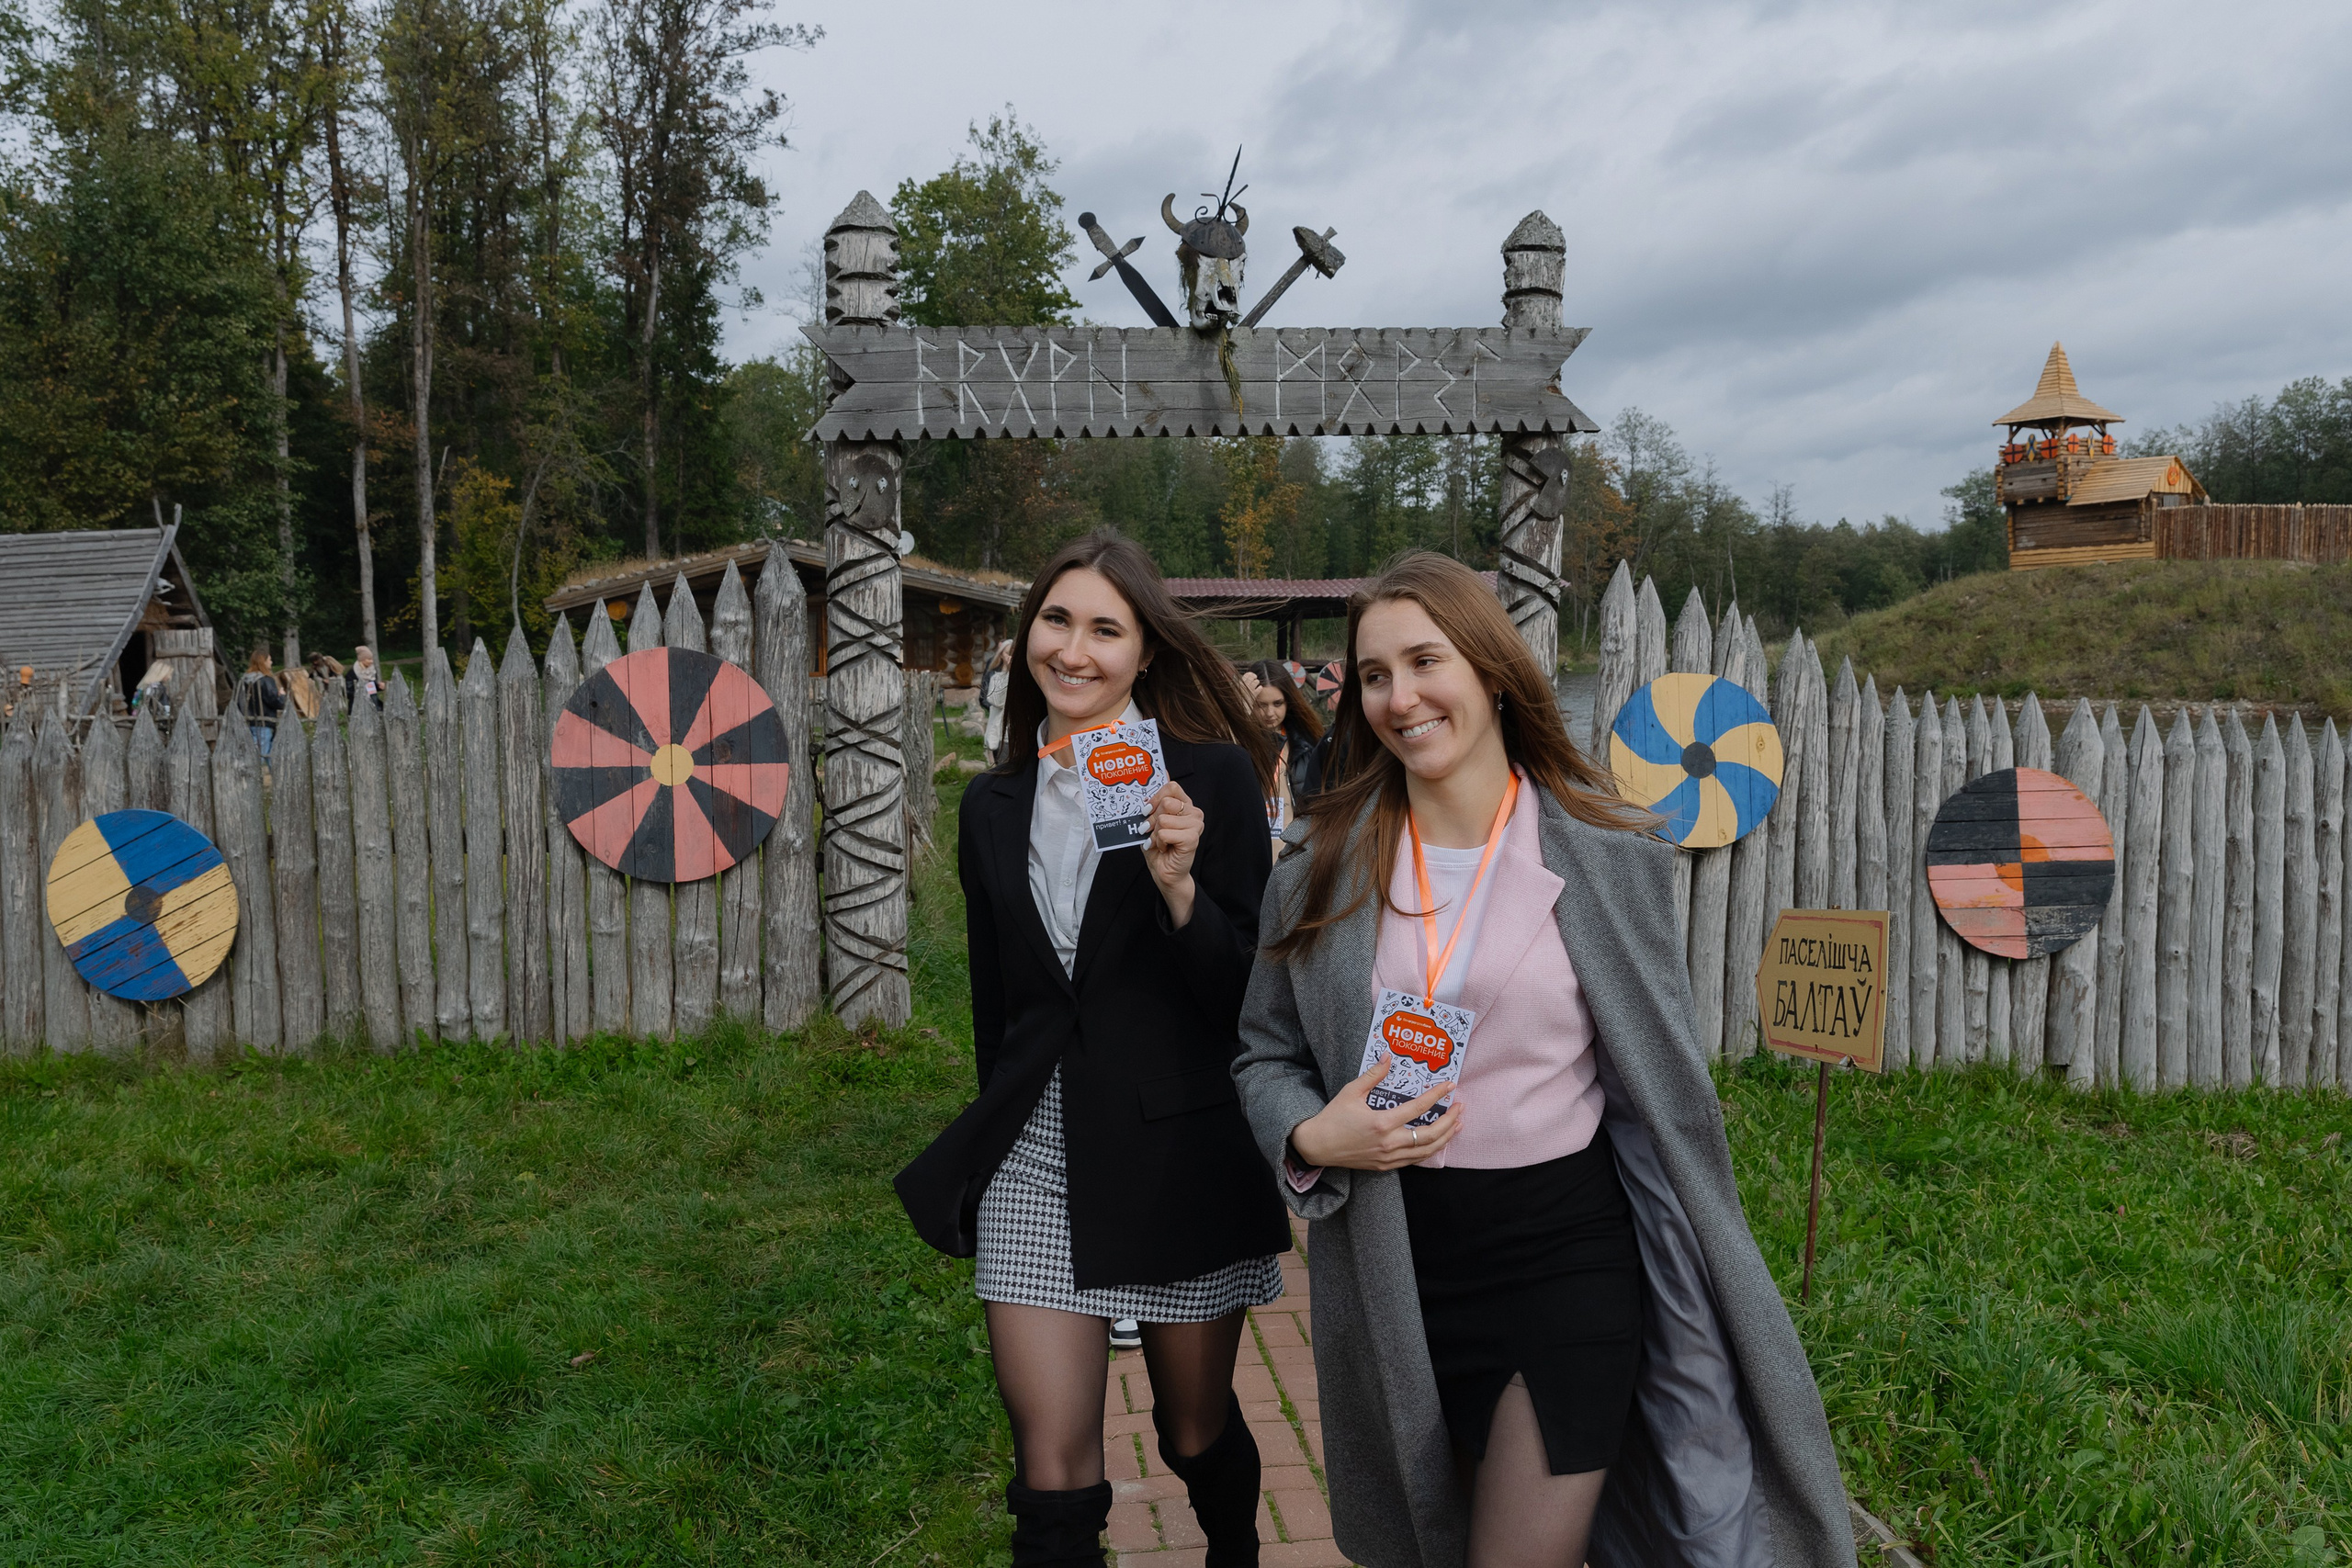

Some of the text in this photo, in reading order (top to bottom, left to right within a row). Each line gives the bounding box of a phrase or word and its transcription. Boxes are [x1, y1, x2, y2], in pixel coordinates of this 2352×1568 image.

[1093, 753, 1146, 773] НОВОЕ
[1101, 764, 1149, 780] ПОКОЛЕНИЕ
[1095, 818, 1122, 830] привет!
[1772, 977, 1873, 1038] БАЛТАЎ
[1388, 1024, 1447, 1051] НОВОЕ
[1391, 1037, 1447, 1060] ПОКОЛЕНИЕ
